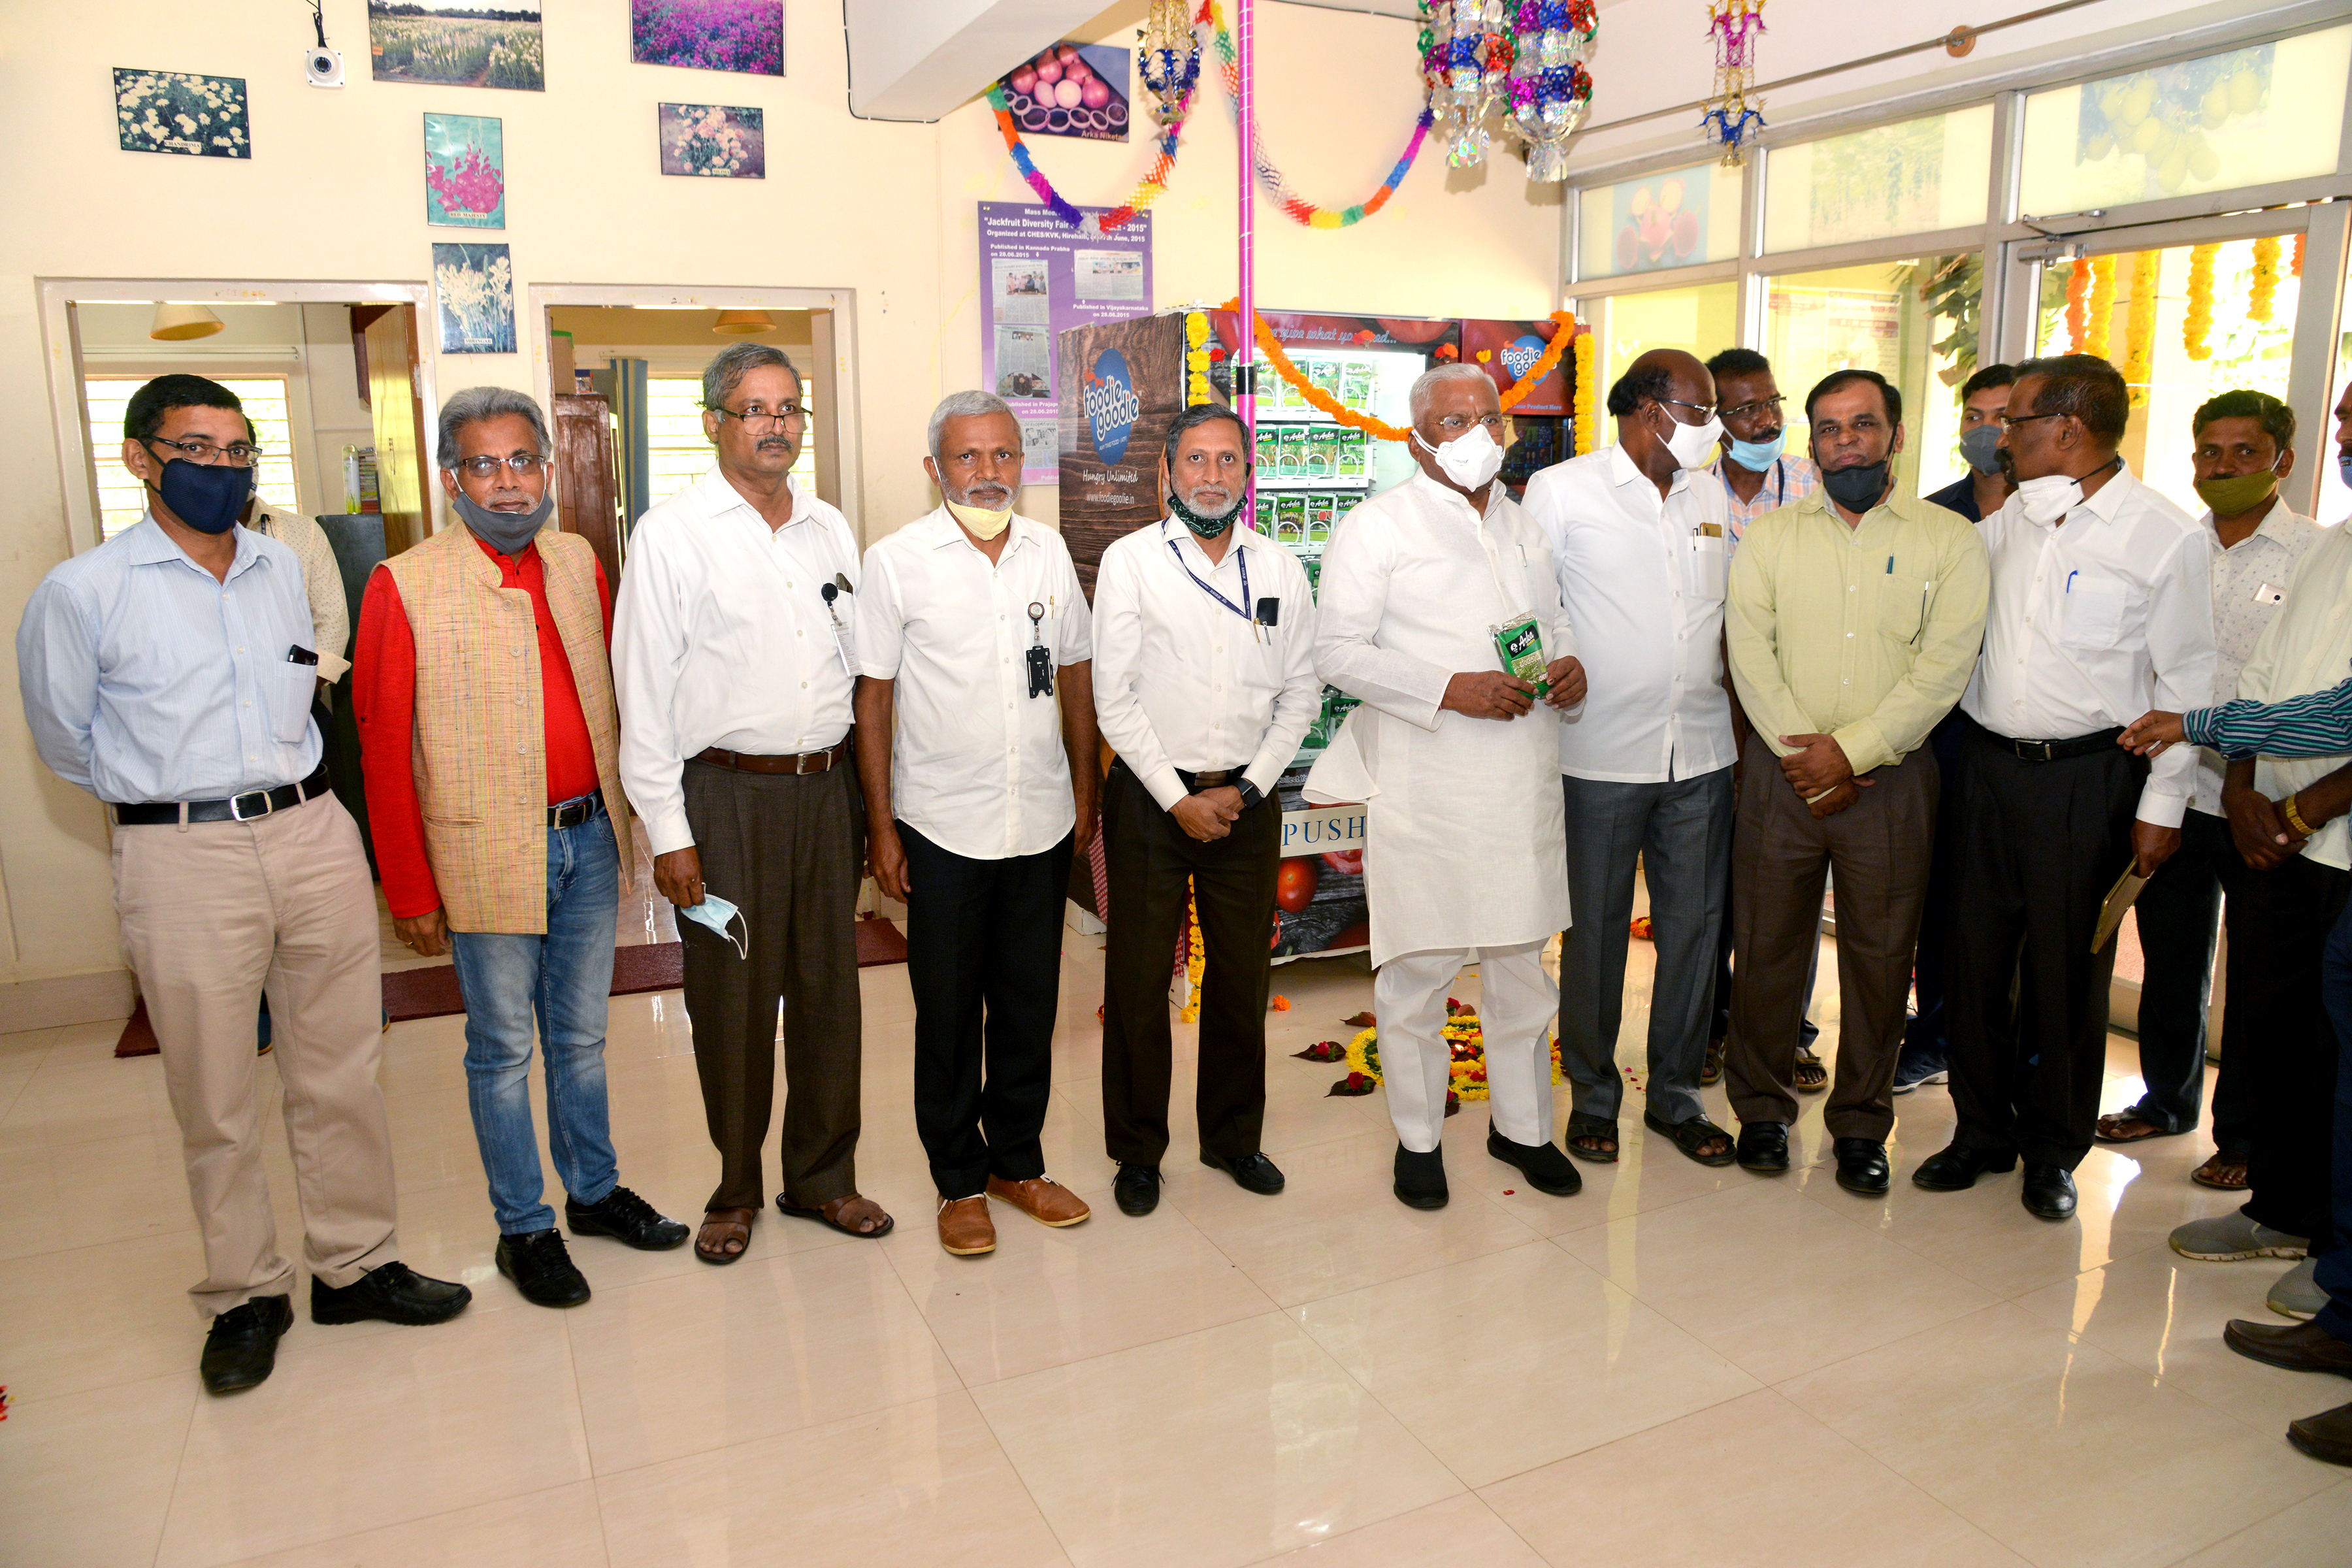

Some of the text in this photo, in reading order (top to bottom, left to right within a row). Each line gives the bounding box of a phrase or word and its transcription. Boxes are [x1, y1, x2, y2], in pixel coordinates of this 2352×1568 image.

[1100, 131, 1127, 141] Niketan
[1022, 219, 1053, 230] Diversity
[1279, 325, 1304, 341] give
[1306, 327, 1337, 340] what
[1501, 347, 1542, 365] foodie
[1084, 375, 1122, 419] foodie
[1097, 389, 1139, 442] goodie
[1256, 431, 1273, 441] Arka
[1318, 431, 1335, 441] Arka
[1347, 432, 1361, 440] Arka
[1083, 468, 1139, 485] Hungry Unlimited
[1286, 500, 1301, 508] Arka
[1315, 499, 1329, 508] Arka
[1344, 498, 1358, 508] Arka
[1519, 630, 1534, 651] Arka
[1339, 703, 1355, 712] Arka
[1282, 815, 1365, 846] PUSH
